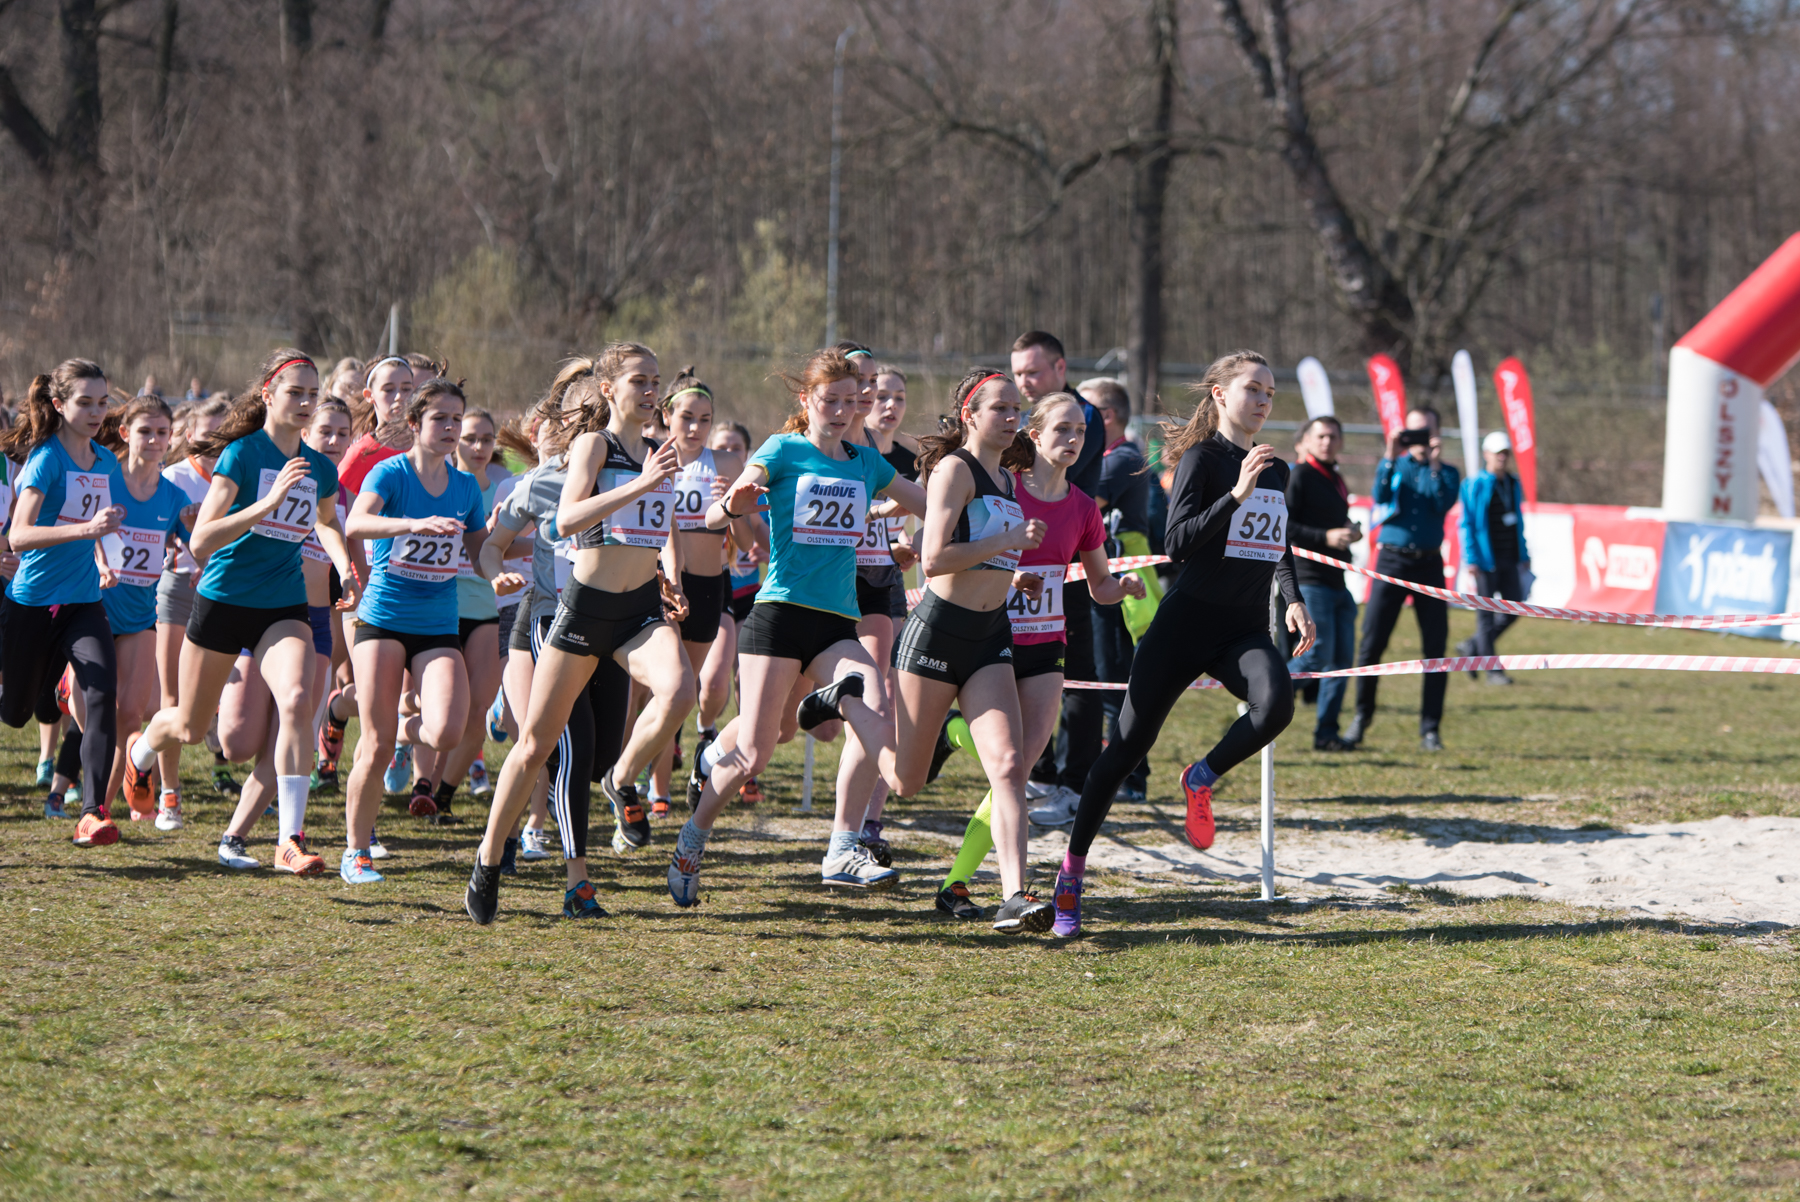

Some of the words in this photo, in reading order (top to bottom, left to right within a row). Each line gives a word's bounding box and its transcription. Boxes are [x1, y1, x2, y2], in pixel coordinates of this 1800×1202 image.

[1711, 379, 1740, 515] OLSZYN
[653, 483, 671, 493] RLEN
[81, 493, 101, 518] 91
[636, 499, 665, 529] 13
[805, 499, 855, 529] 226
[265, 529, 290, 540] OLSZYNA
[1239, 512, 1281, 543] 526
[134, 533, 159, 543] ORLEN
[626, 536, 653, 545] OLSZYNA
[807, 536, 836, 545] OLSZYNA
[121, 547, 149, 571] 92
[301, 548, 321, 559] LSZYNA
[401, 539, 454, 566] 223
[1239, 550, 1265, 559] OLSZYNA
[400, 569, 428, 580] OLSZYNA
[1007, 587, 1053, 616] 401
[920, 655, 948, 669] SMS
